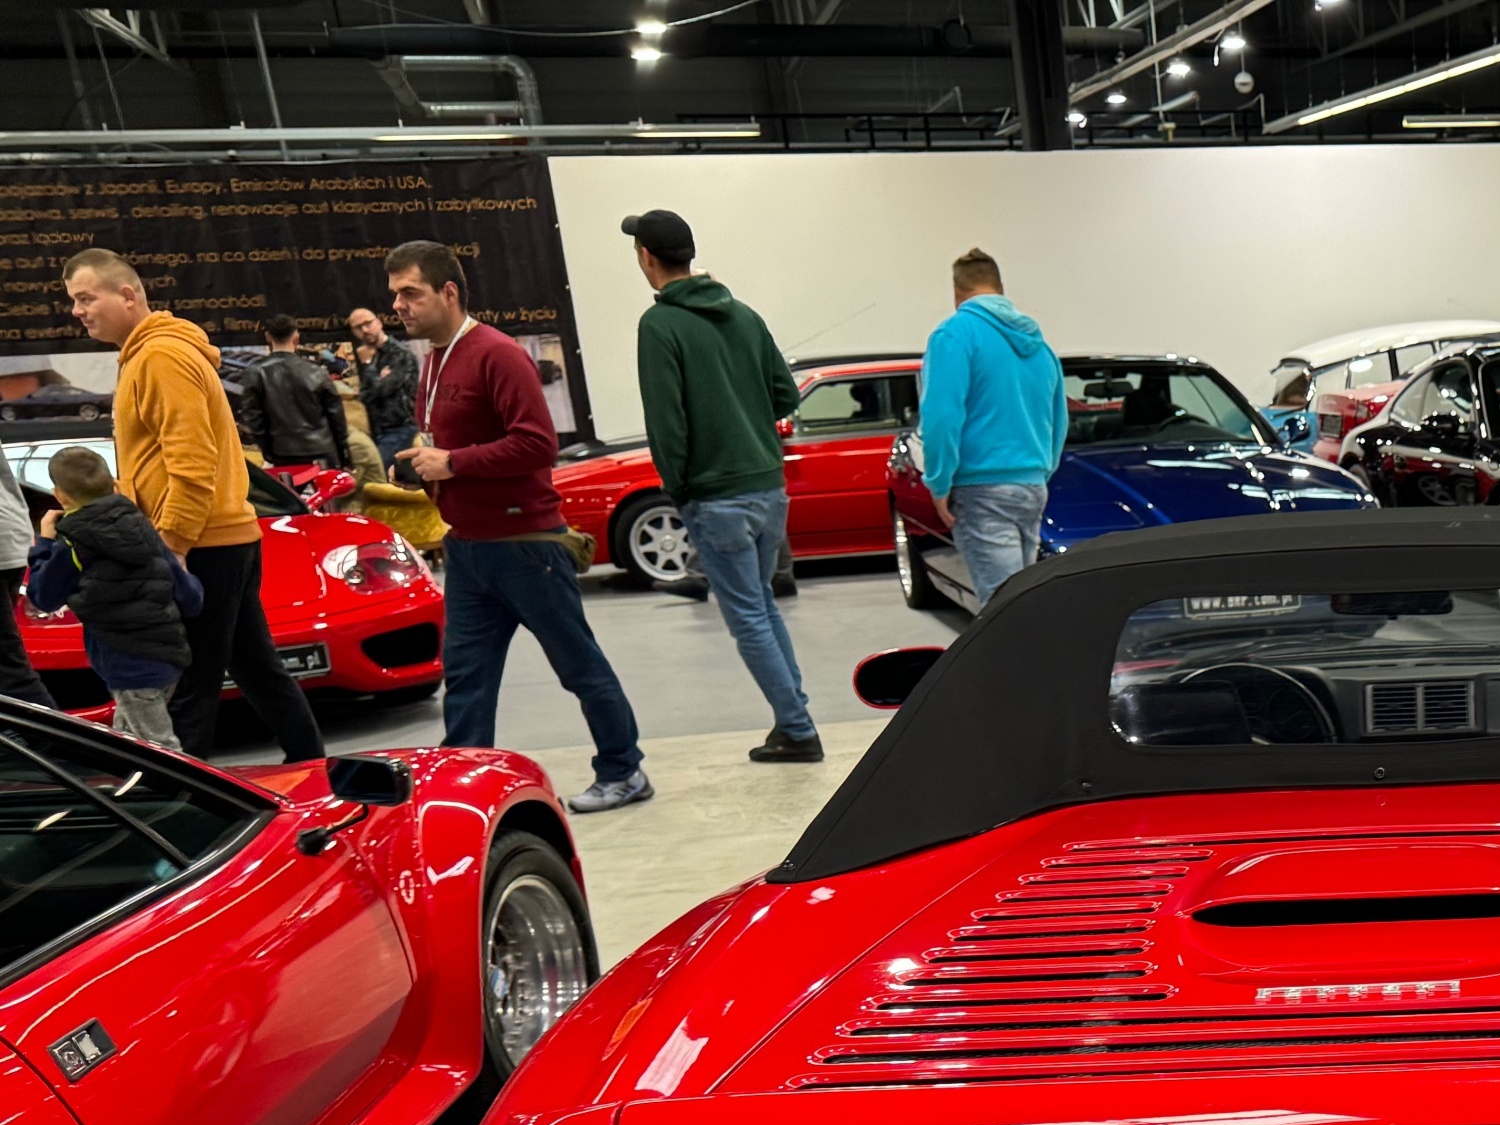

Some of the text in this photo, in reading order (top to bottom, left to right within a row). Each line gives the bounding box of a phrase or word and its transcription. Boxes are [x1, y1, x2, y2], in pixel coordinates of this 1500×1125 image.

[309, 175, 386, 191] Arabskich
[397, 175, 433, 190] USA.
[333, 198, 424, 214] klasycznych
[436, 196, 538, 212] zabytkowych
